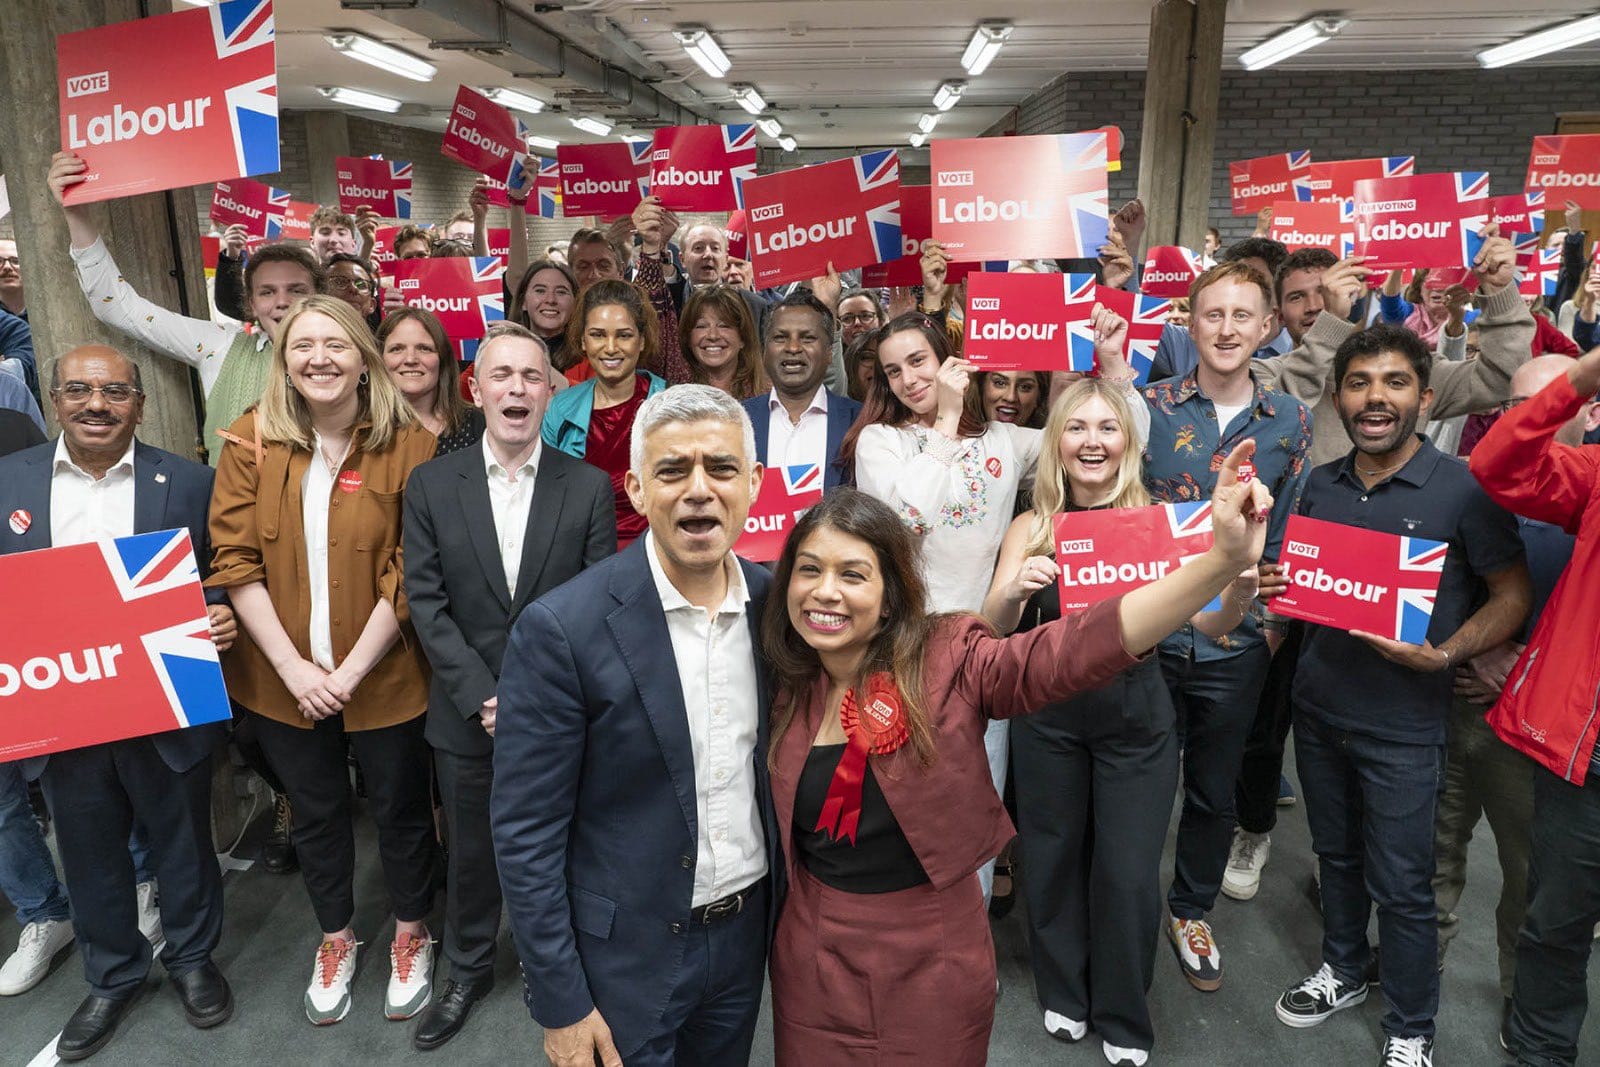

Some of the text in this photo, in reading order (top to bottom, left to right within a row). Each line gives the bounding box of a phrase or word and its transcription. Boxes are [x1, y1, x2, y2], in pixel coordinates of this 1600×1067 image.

[69, 75, 107, 93] VOTE
[458, 106, 475, 118] VOTE
[68, 96, 211, 150] Labour
[450, 119, 509, 158] Labour
[654, 151, 669, 159] VOTE
[1536, 156, 1558, 165] VOTE
[650, 166, 723, 186] Labour
[940, 173, 972, 184] VOTE
[1529, 170, 1600, 188] Labou
[340, 184, 389, 200] Labour
[564, 178, 631, 195] Labour
[1233, 182, 1288, 199] Labour
[214, 193, 262, 219] Labour
[753, 205, 782, 219] VOTE
[938, 196, 1054, 224] Labour
[1377, 201, 1414, 210] VOTING
[754, 216, 857, 255] Labour
[1272, 230, 1335, 246] Labour
[1359, 219, 1452, 242] Labour
[400, 280, 419, 288] VOTE
[408, 295, 472, 312] abour
[974, 299, 998, 308] VOTE
[970, 318, 1058, 340] Labour
[744, 513, 786, 534] our
[1063, 541, 1092, 552] VOTE
[1290, 542, 1318, 556] VOTE
[1062, 560, 1170, 587] Labour
[1281, 561, 1387, 604] Labour
